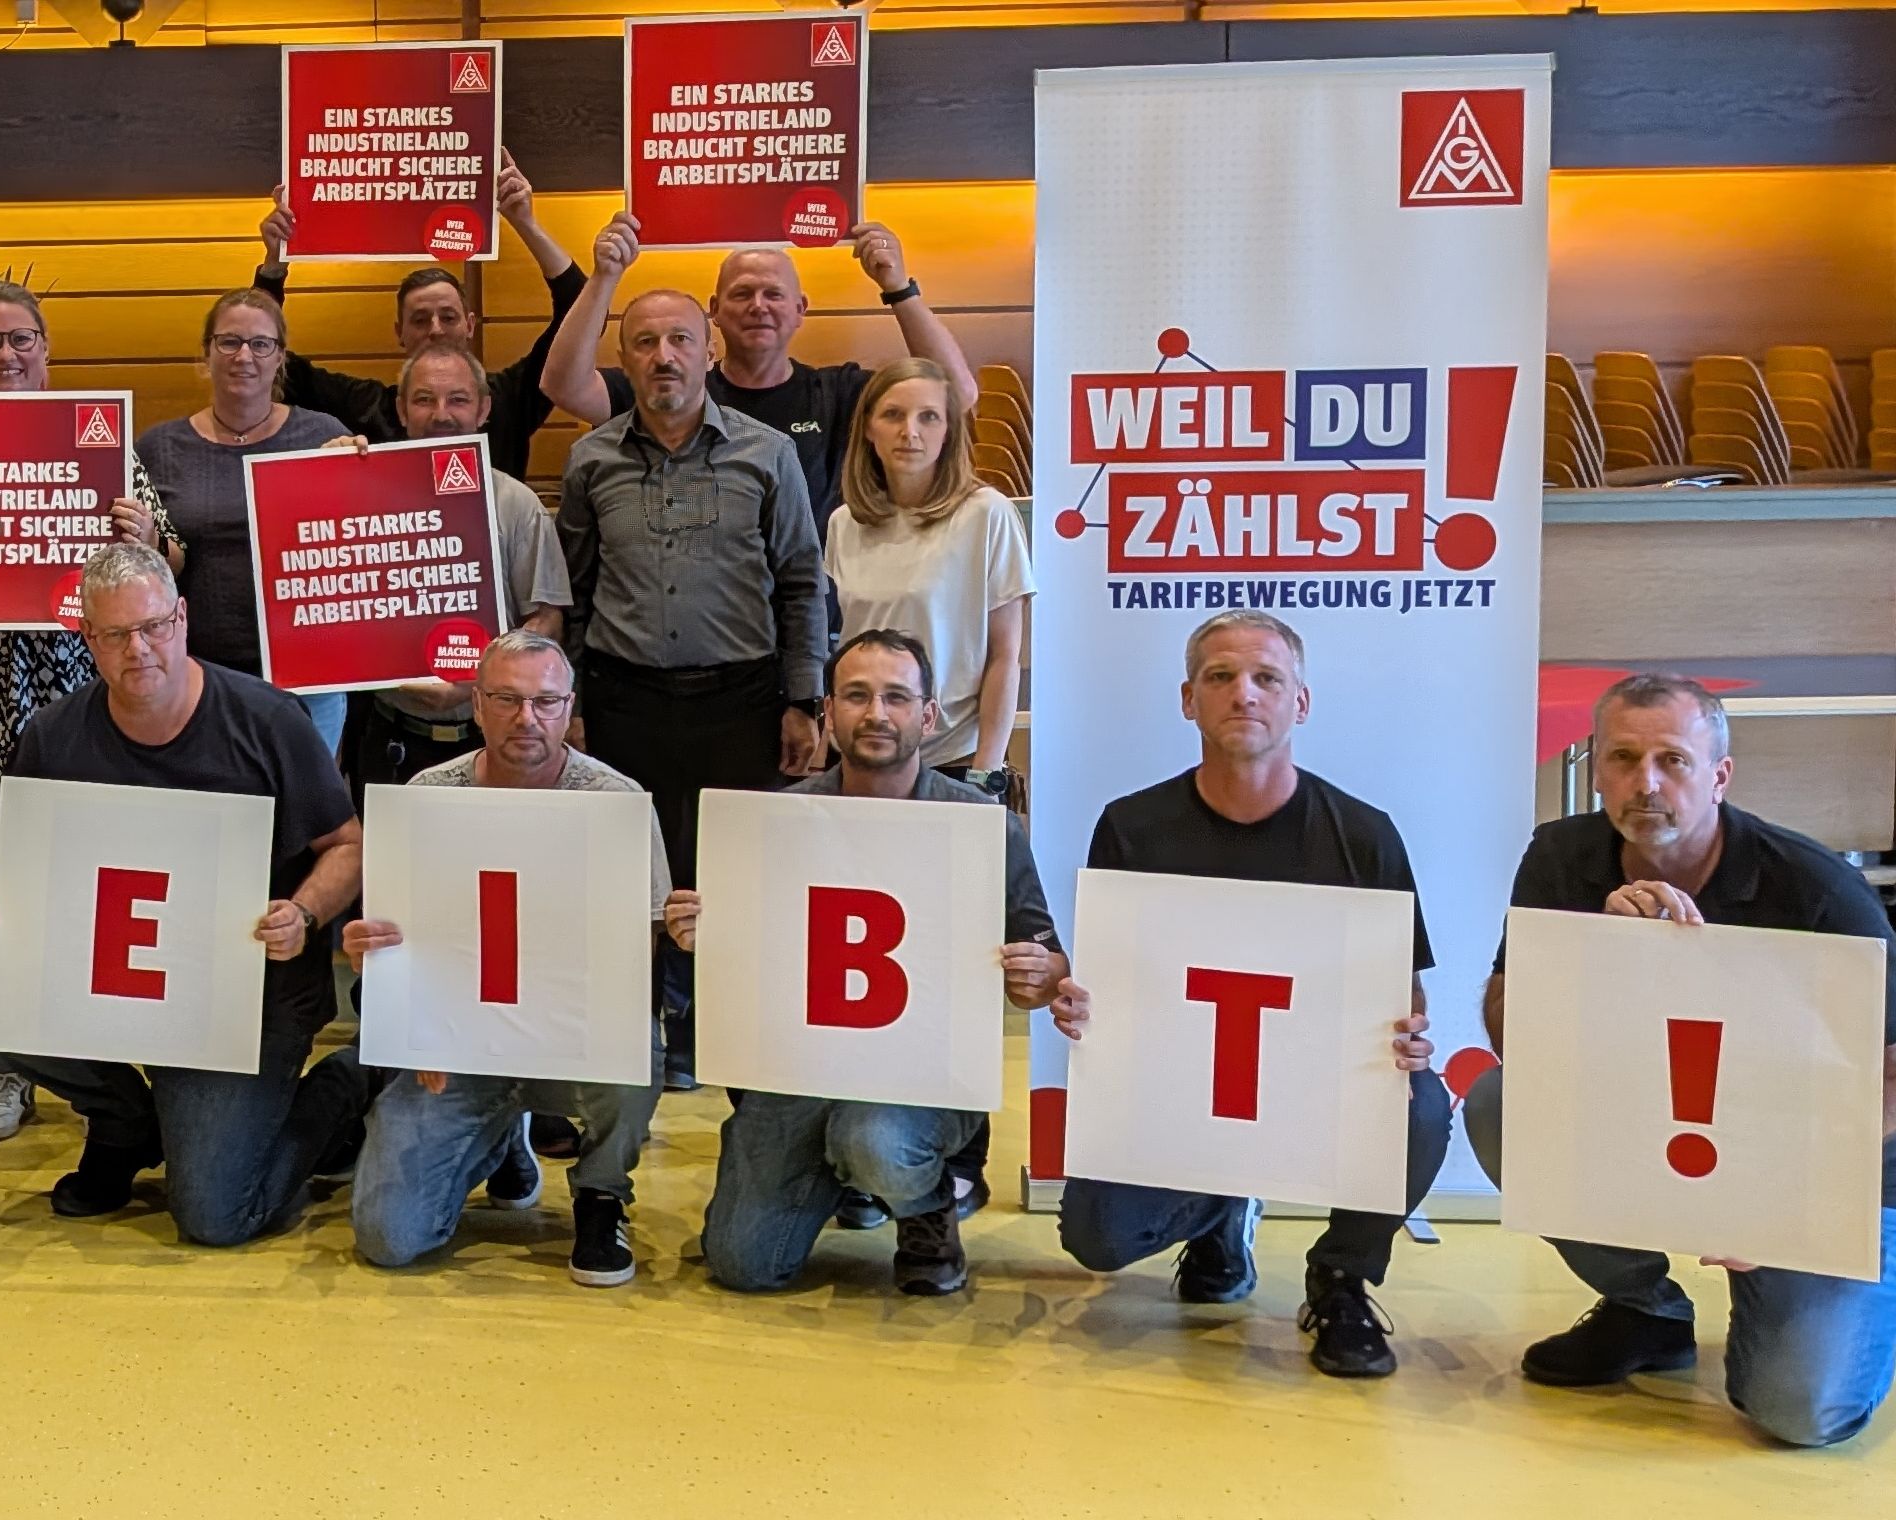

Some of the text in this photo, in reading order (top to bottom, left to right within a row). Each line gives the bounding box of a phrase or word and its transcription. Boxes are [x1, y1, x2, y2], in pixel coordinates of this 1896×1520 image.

[671, 81, 813, 105] EIN STARKES
[325, 107, 452, 127] EIN STARKES
[653, 108, 831, 132] INDUSTRIELAND
[309, 132, 468, 152] INDUSTRIELAND
[644, 134, 846, 159] BRAUCHT SICHERE
[301, 156, 482, 177] BRAUCHT SICHERE
[658, 157, 839, 185] ARBEITSPLÄTZE!
[312, 177, 476, 201] ARBEITSPLÄTZE!
[808, 203, 826, 213] WIR
[447, 220, 464, 229] WIR
[795, 214, 835, 225] MACHEN
[435, 230, 472, 241] MACHEN
[790, 225, 838, 237] ZUKUNFT!
[431, 239, 473, 251] ZUKUNFT!
[791, 422, 821, 432] GEA
[1087, 383, 1411, 449] WEIL DU
[20, 516, 112, 537] SICHERE
[298, 510, 442, 543] EIN STARKES
[1124, 479, 1409, 557] ZÄHLST
[282, 537, 463, 573] INDUSTRIELAND
[276, 562, 481, 600] BRAUCHT SICHERE
[294, 589, 477, 626] ARBEITSPLÄTZE!
[1108, 580, 1495, 613] TARIFBEWEGUNG JETZT
[449, 635, 469, 645] WIR
[438, 647, 479, 657] MACHEN
[91, 867, 169, 999] E
[479, 870, 518, 1004] I
[807, 886, 908, 1028] B
[1187, 968, 1293, 1120] T
[1666, 1019, 1723, 1178] !
